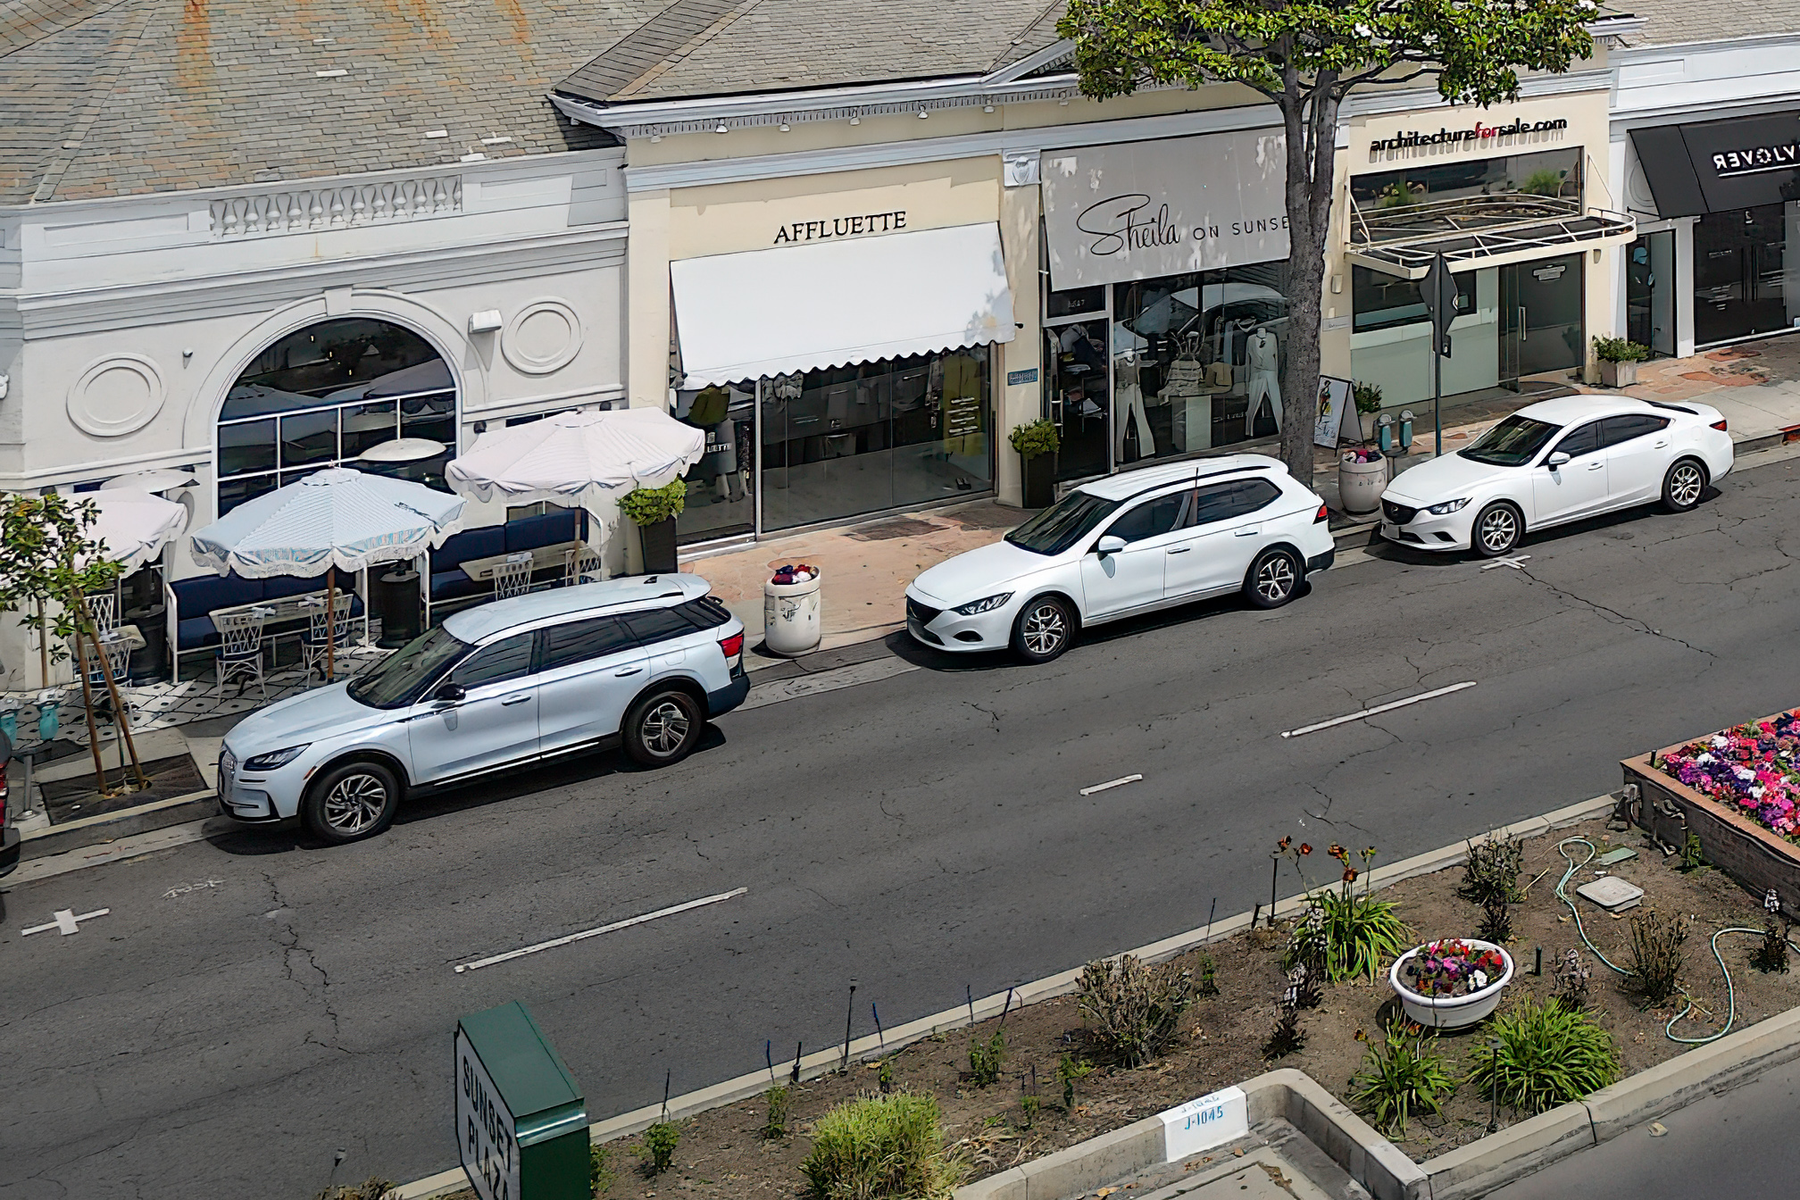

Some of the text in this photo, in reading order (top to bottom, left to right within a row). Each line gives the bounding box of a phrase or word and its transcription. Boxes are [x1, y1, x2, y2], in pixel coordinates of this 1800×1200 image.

[1370, 117, 1568, 152] architectureforsale.com
[773, 210, 907, 244] AFFLUETTE
[1076, 194, 1290, 256] Sheila ON SUNSE
[463, 1055, 513, 1174] SUNSET
[1184, 1105, 1224, 1130] J-1045
